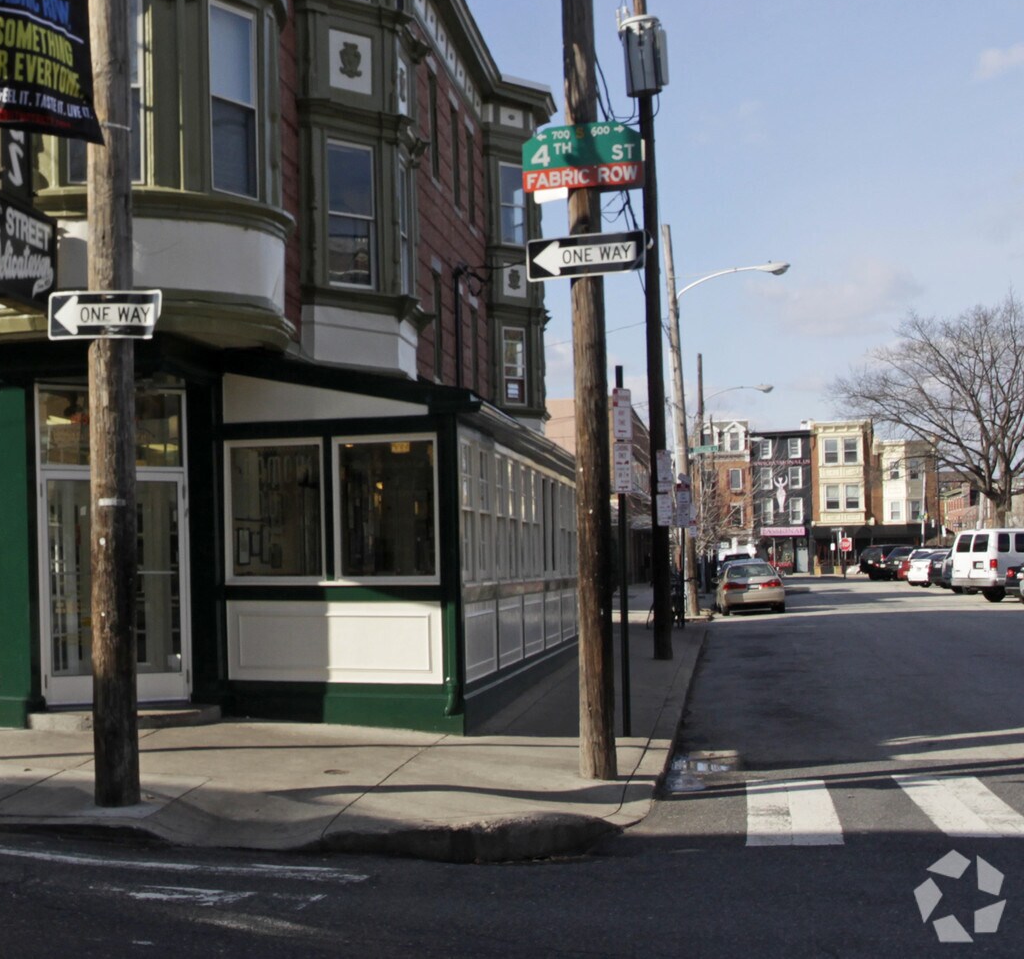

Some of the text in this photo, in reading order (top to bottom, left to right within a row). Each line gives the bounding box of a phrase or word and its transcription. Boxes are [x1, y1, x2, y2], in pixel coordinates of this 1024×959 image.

[18, 89, 33, 107] IT.
[66, 103, 83, 120] LIVE
[551, 129, 570, 140] 700
[590, 126, 610, 137] 600
[531, 142, 635, 167] 4TH ST
[526, 165, 639, 190] FABRIC ROW
[5, 205, 51, 252] STREET
[562, 243, 632, 265] ONE WAY
[80, 306, 152, 324] ONE WAY
